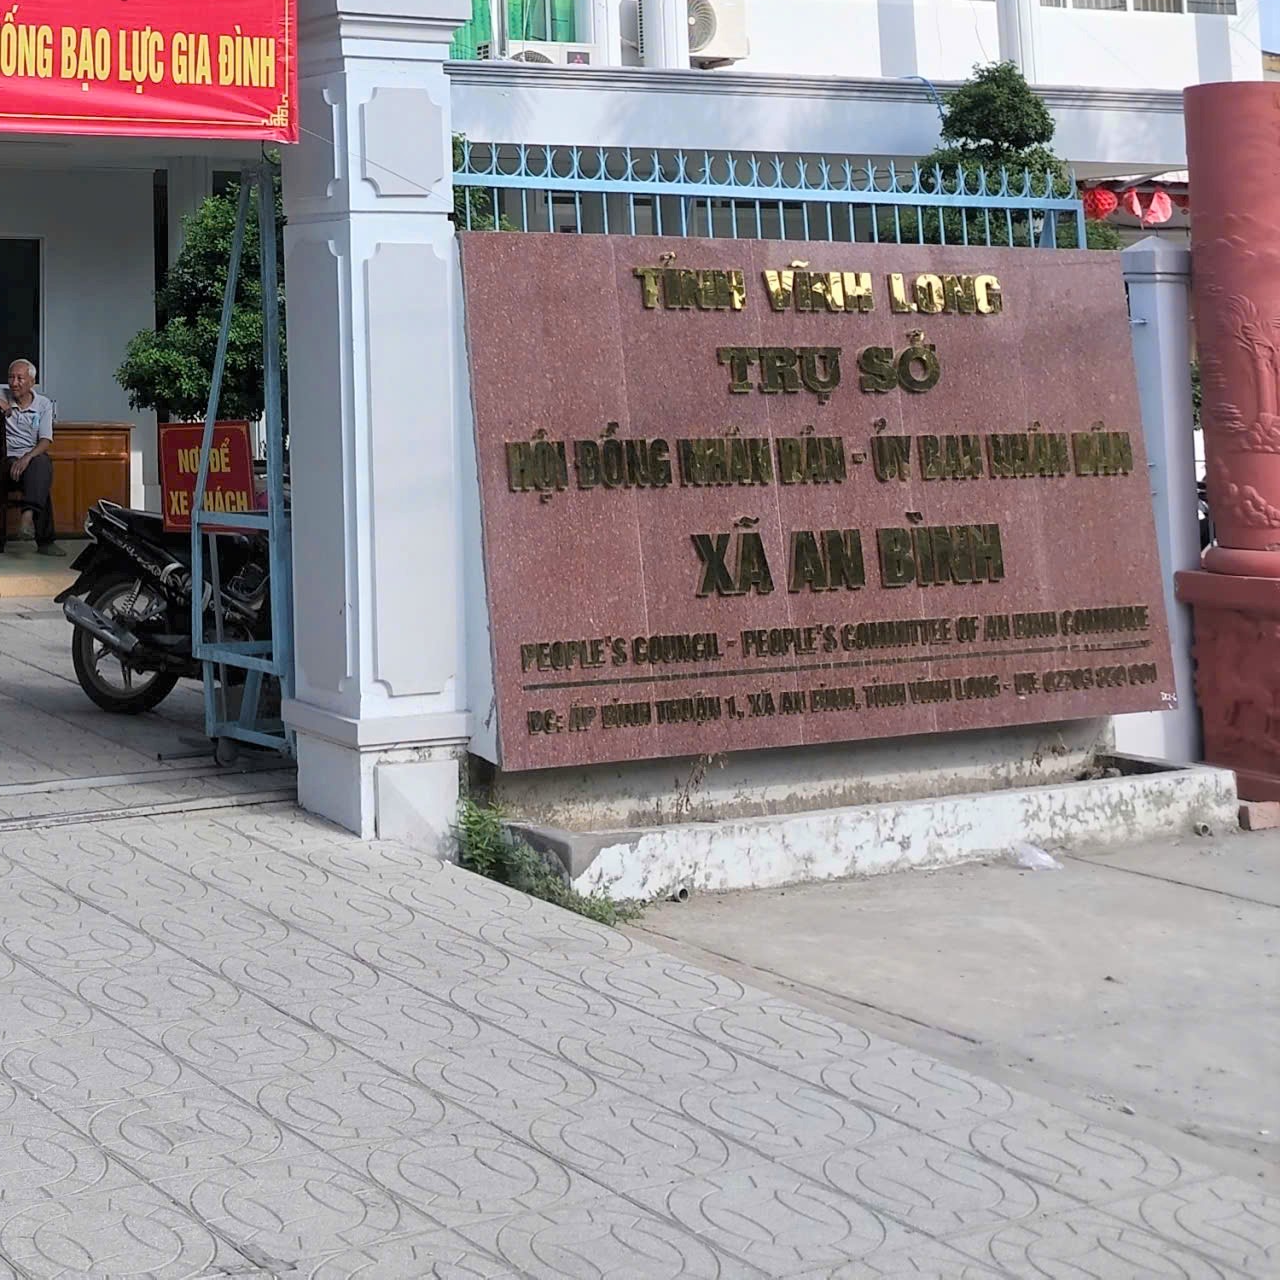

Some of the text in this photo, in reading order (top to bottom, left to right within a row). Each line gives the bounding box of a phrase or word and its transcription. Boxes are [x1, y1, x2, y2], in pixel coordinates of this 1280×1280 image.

[60, 26, 112, 92] BẠO
[118, 26, 164, 94] LỰC
[171, 32, 213, 86] GIA
[219, 25, 277, 88] ĐÌNH
[887, 272, 1005, 317] LONG
[716, 327, 943, 407] TRỤ SỞ
[177, 437, 231, 474] NƠ ĐỂ
[169, 486, 249, 516] XE HÁCH
[690, 511, 1006, 598] XÃ AN BÌNH
[520, 635, 628, 673] PEOPLE'S
[631, 632, 724, 667] COUNCIL
[740, 623, 839, 658] PEOPLE'S
